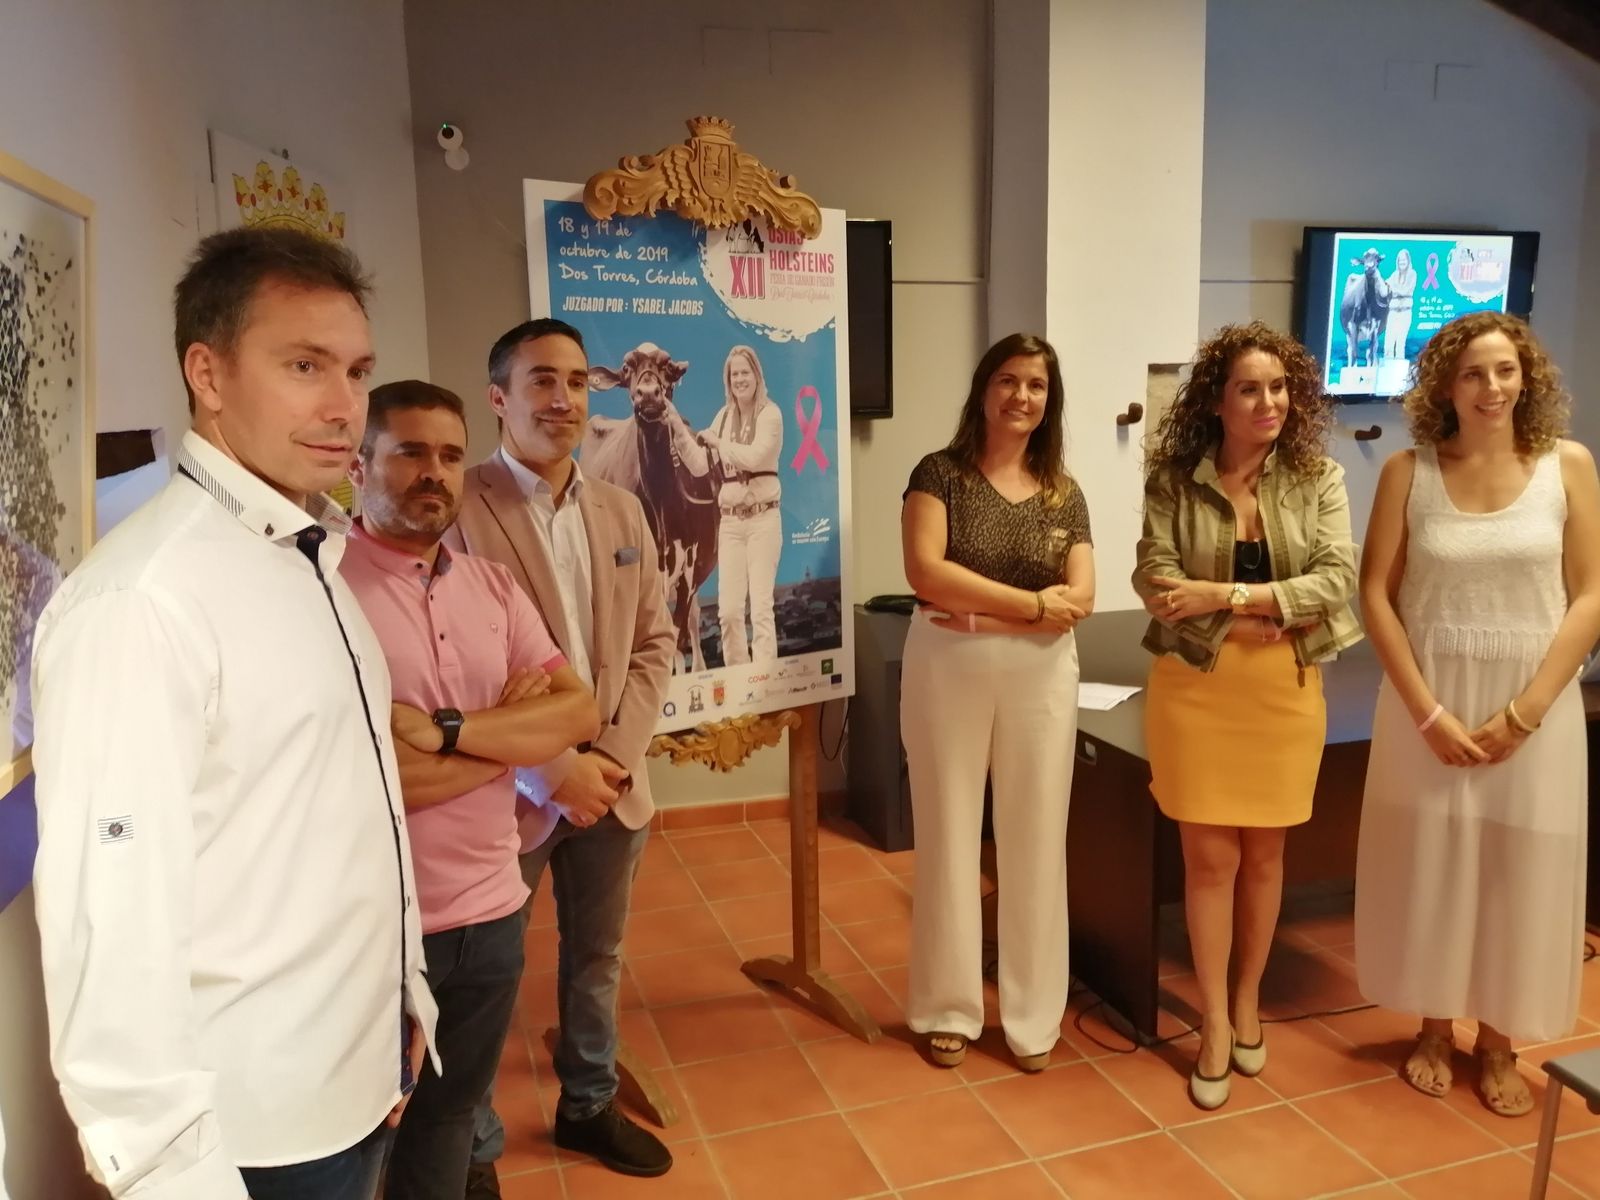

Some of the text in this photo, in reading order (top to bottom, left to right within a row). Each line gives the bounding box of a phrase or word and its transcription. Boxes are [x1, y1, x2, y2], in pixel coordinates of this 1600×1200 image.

[558, 217, 633, 239] 18 y 19 de
[560, 242, 669, 262] octubre de 2019
[769, 250, 834, 274] HOLSTEINS
[558, 263, 698, 286] Dos Torres, Córdoba
[729, 255, 765, 300] XII
[563, 296, 604, 313] JUZGADO
[632, 298, 666, 314] YSABEL
[668, 299, 704, 316] JACOBS
